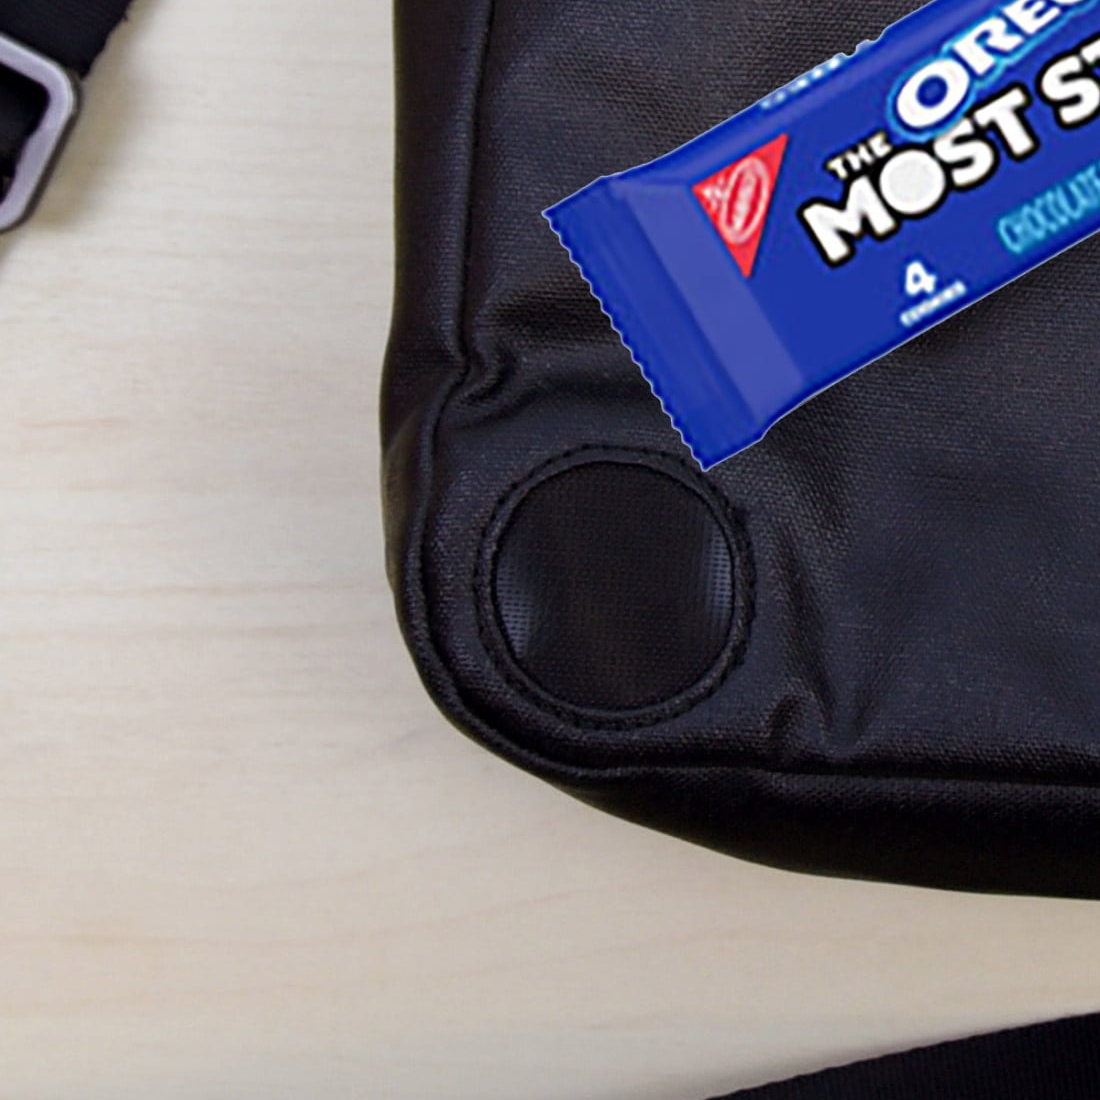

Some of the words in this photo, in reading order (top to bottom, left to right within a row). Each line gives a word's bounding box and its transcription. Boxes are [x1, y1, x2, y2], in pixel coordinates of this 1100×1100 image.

[801, 85, 1036, 264] MOST
[825, 131, 893, 179] THE
[905, 261, 937, 296] 4
